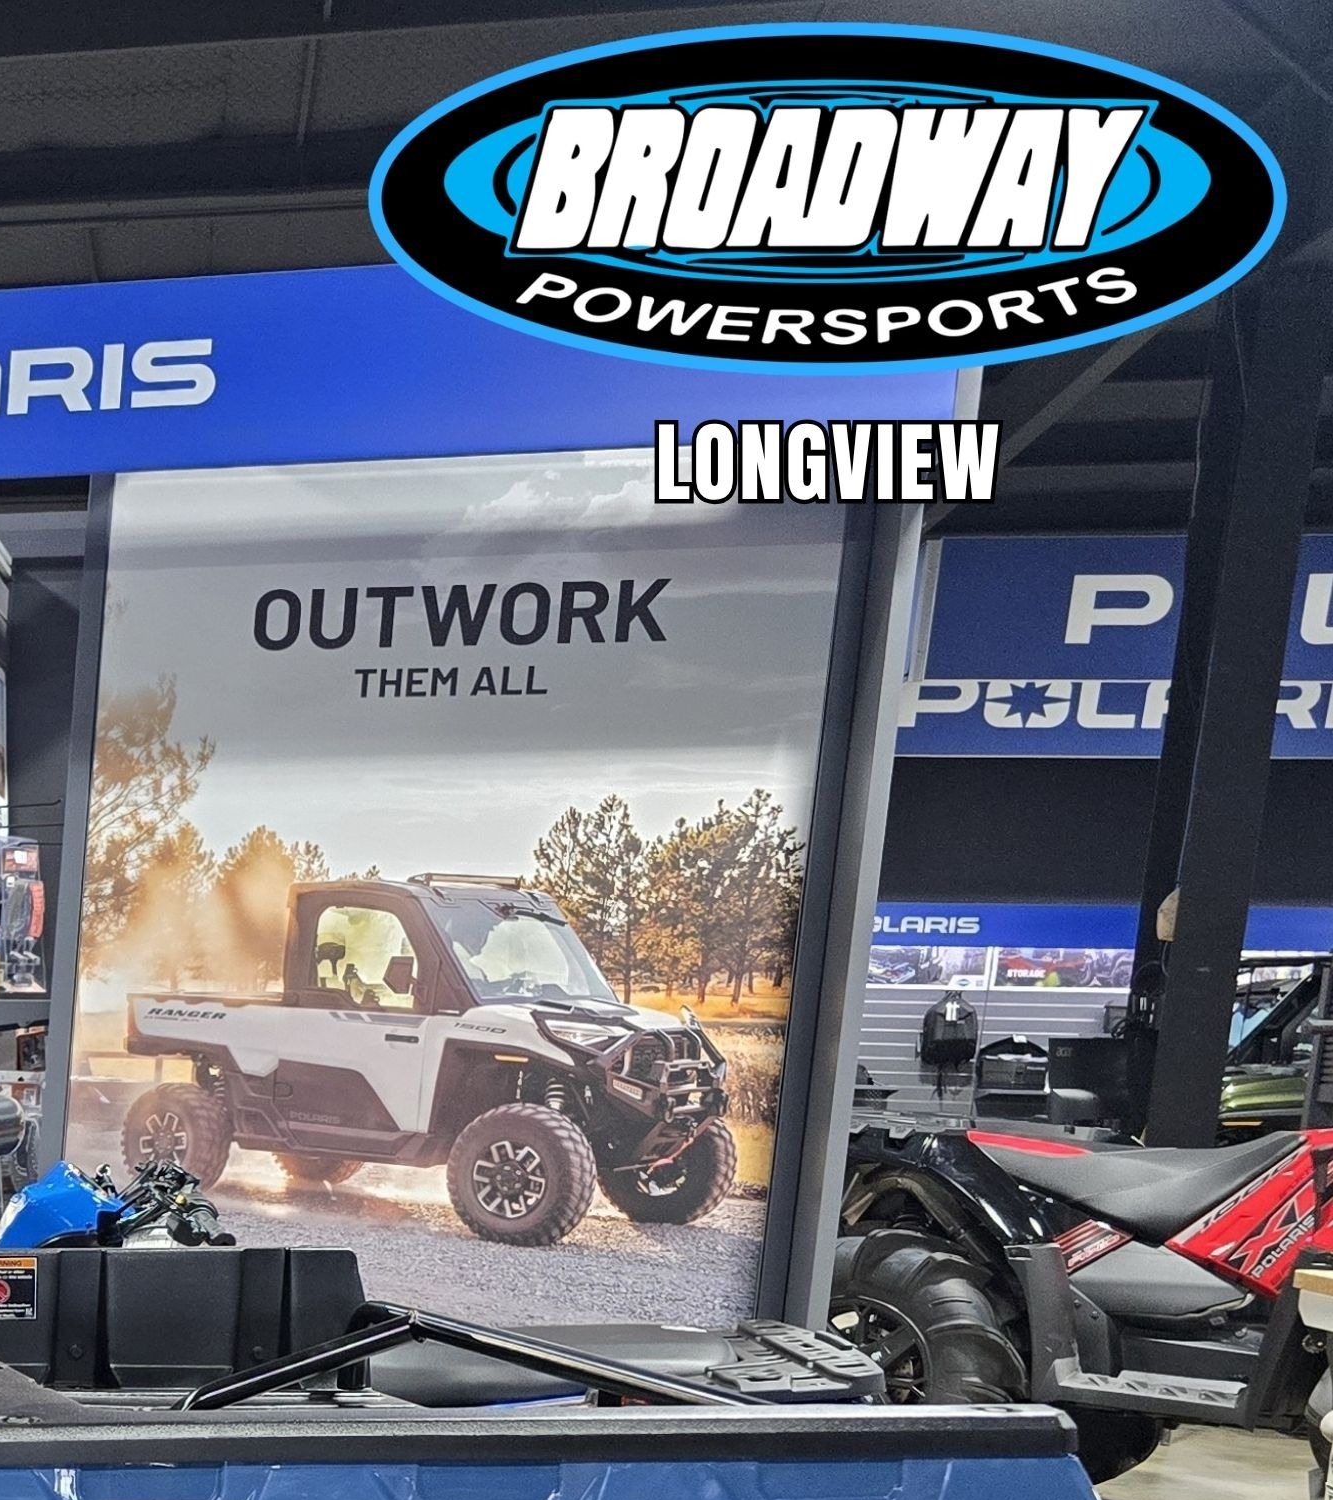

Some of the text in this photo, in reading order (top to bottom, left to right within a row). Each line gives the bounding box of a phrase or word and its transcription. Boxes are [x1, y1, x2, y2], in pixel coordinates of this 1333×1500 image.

[253, 577, 672, 652] OUTWORK
[354, 665, 548, 699] THEM ALL
[1007, 968, 1046, 979] STORAGE
[147, 1007, 227, 1020] RANGER
[453, 1021, 508, 1035] 1500
[1251, 1213, 1316, 1280] POLARIS
